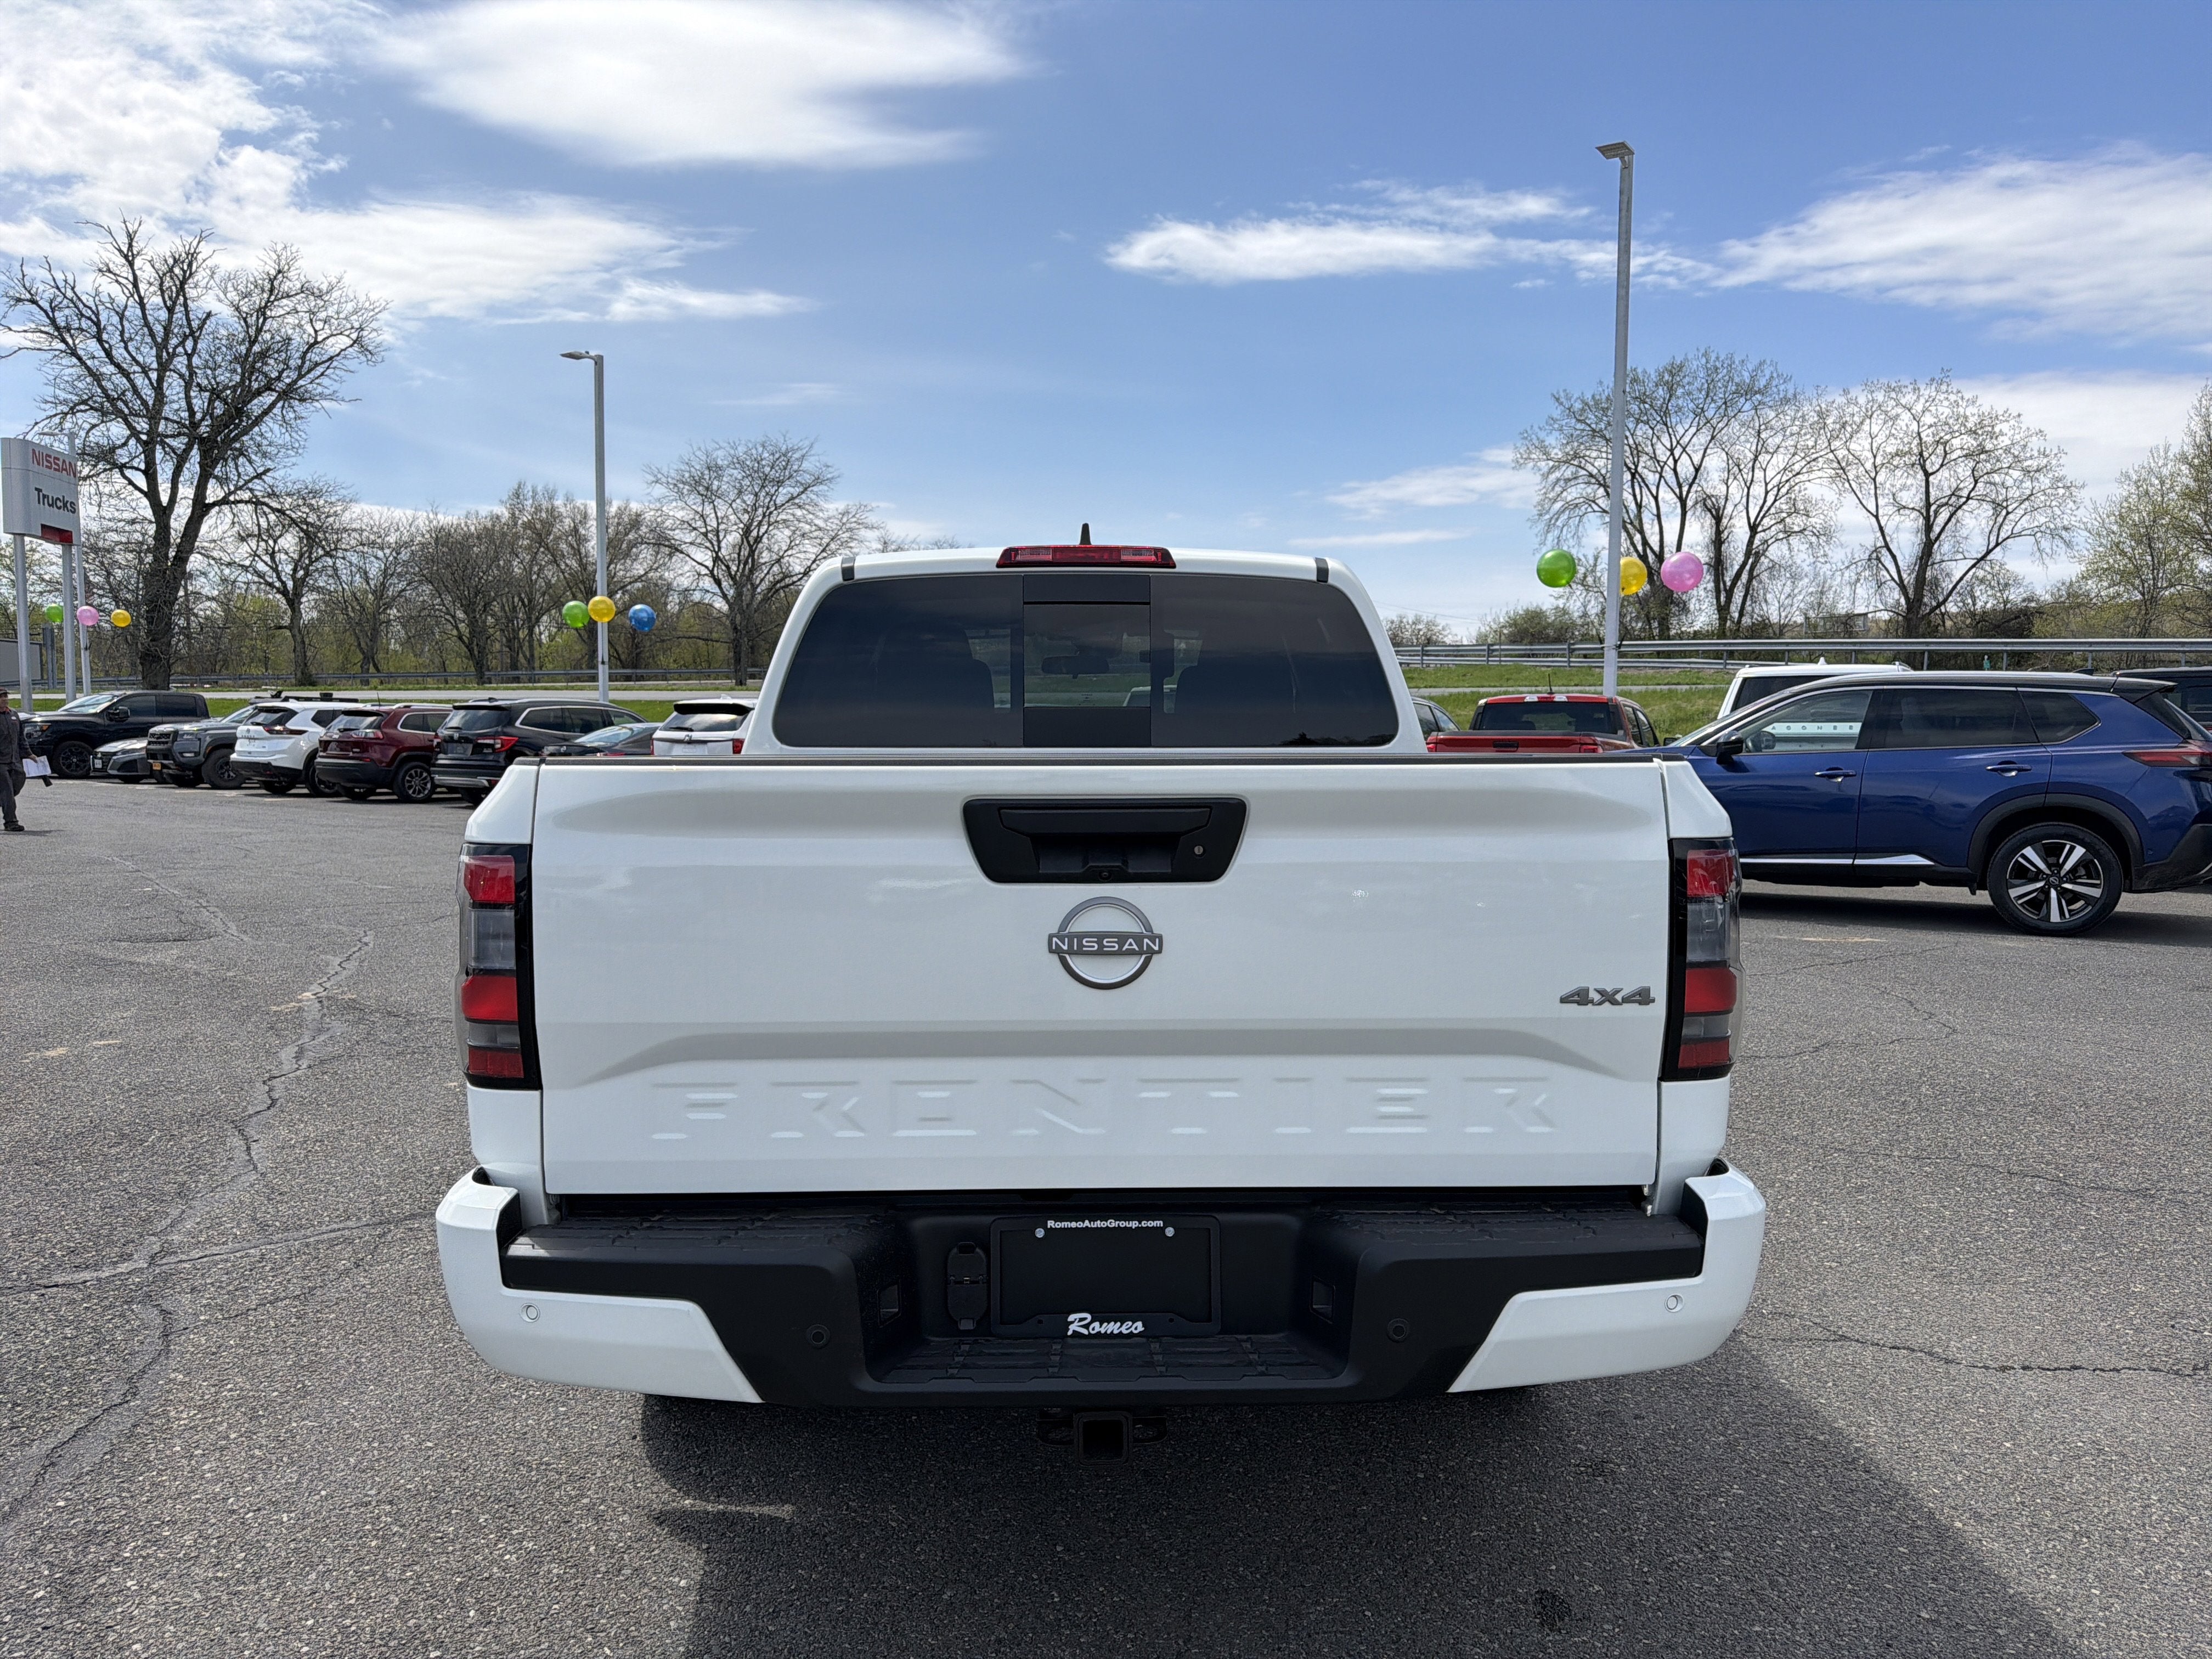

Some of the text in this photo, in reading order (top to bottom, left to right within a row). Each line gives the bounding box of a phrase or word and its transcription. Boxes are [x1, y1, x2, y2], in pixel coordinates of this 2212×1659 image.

[32, 448, 77, 478] NISSAN
[34, 487, 76, 514] Trucks
[1052, 937, 1159, 951] NISSAN
[651, 1077, 1556, 1139] FRONTIER
[1047, 1220, 1163, 1228] RomeoAutoGroup.com
[1068, 1313, 1144, 1335] Romeo
